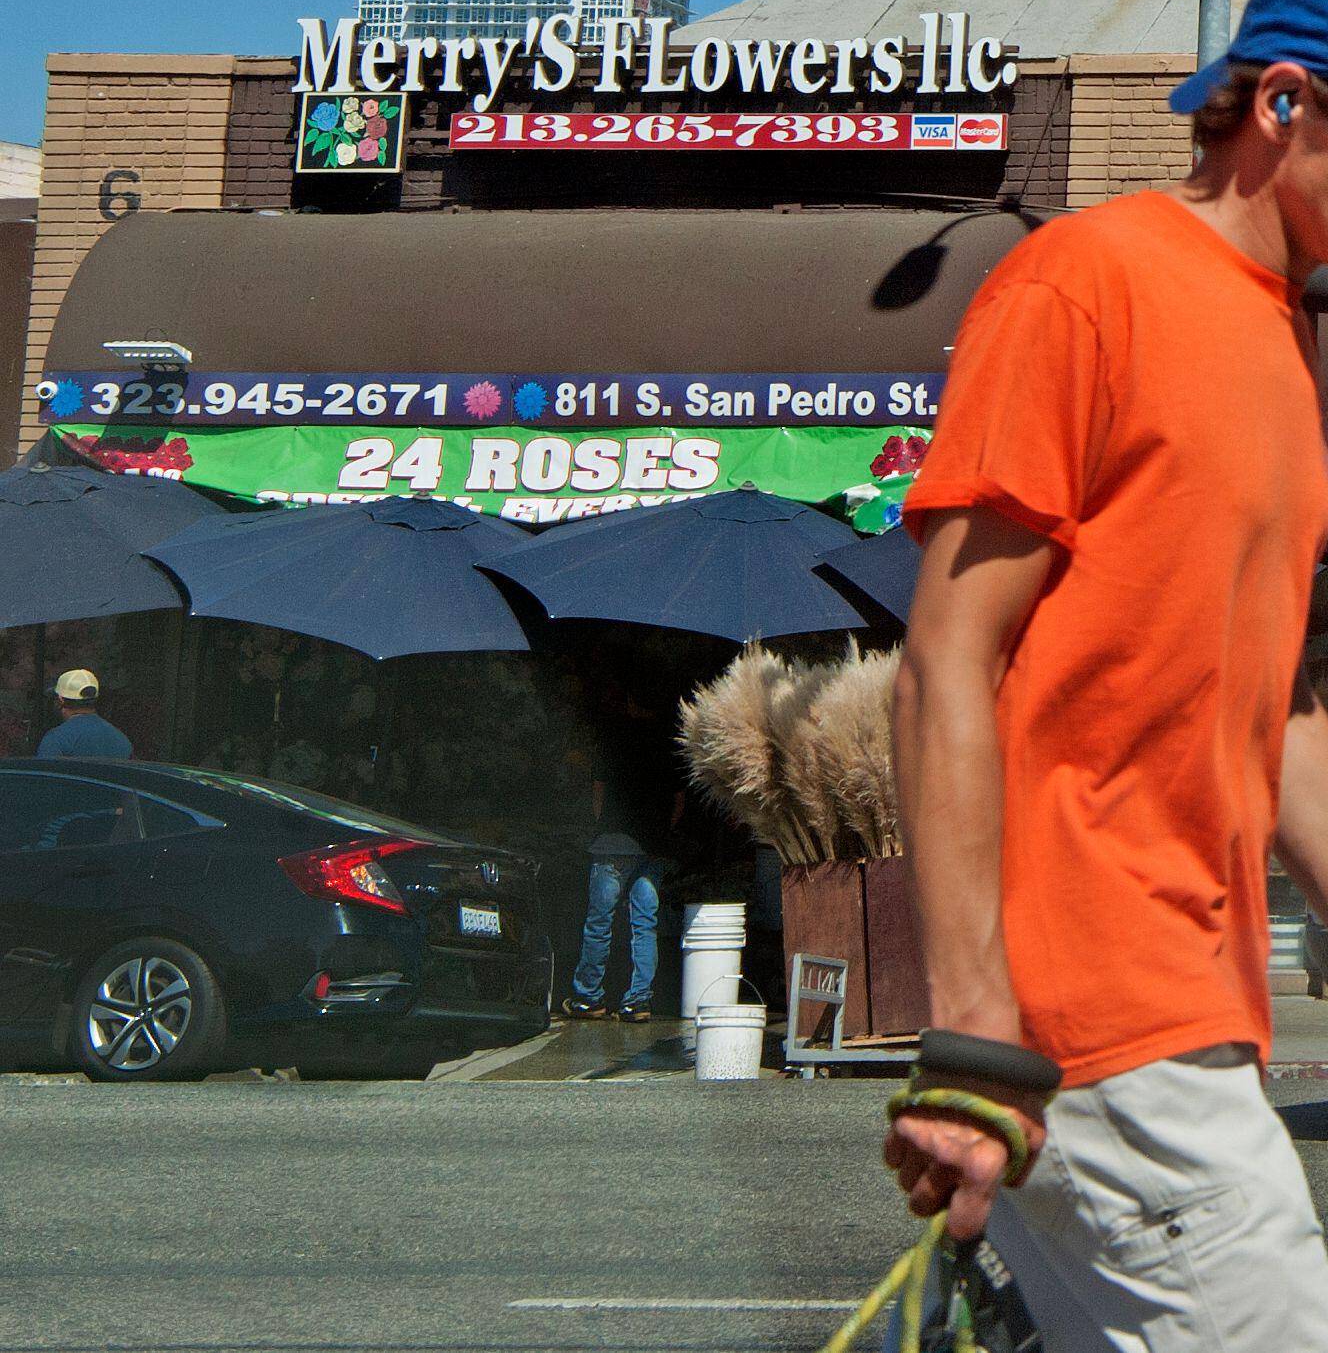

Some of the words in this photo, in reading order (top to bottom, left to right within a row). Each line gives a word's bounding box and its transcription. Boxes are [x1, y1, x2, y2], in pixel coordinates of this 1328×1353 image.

[456, 114, 899, 146] 213.265-7393
[919, 127, 949, 138] VISA
[98, 170, 141, 221] 6
[90, 382, 448, 416] 323.945-2671
[555, 382, 620, 416] 811
[635, 382, 672, 416] S.
[684, 382, 755, 416] San
[768, 383, 876, 416] Pedro
[887, 382, 939, 416] St.
[337, 435, 443, 493] 24
[464, 435, 721, 494] ROSES
